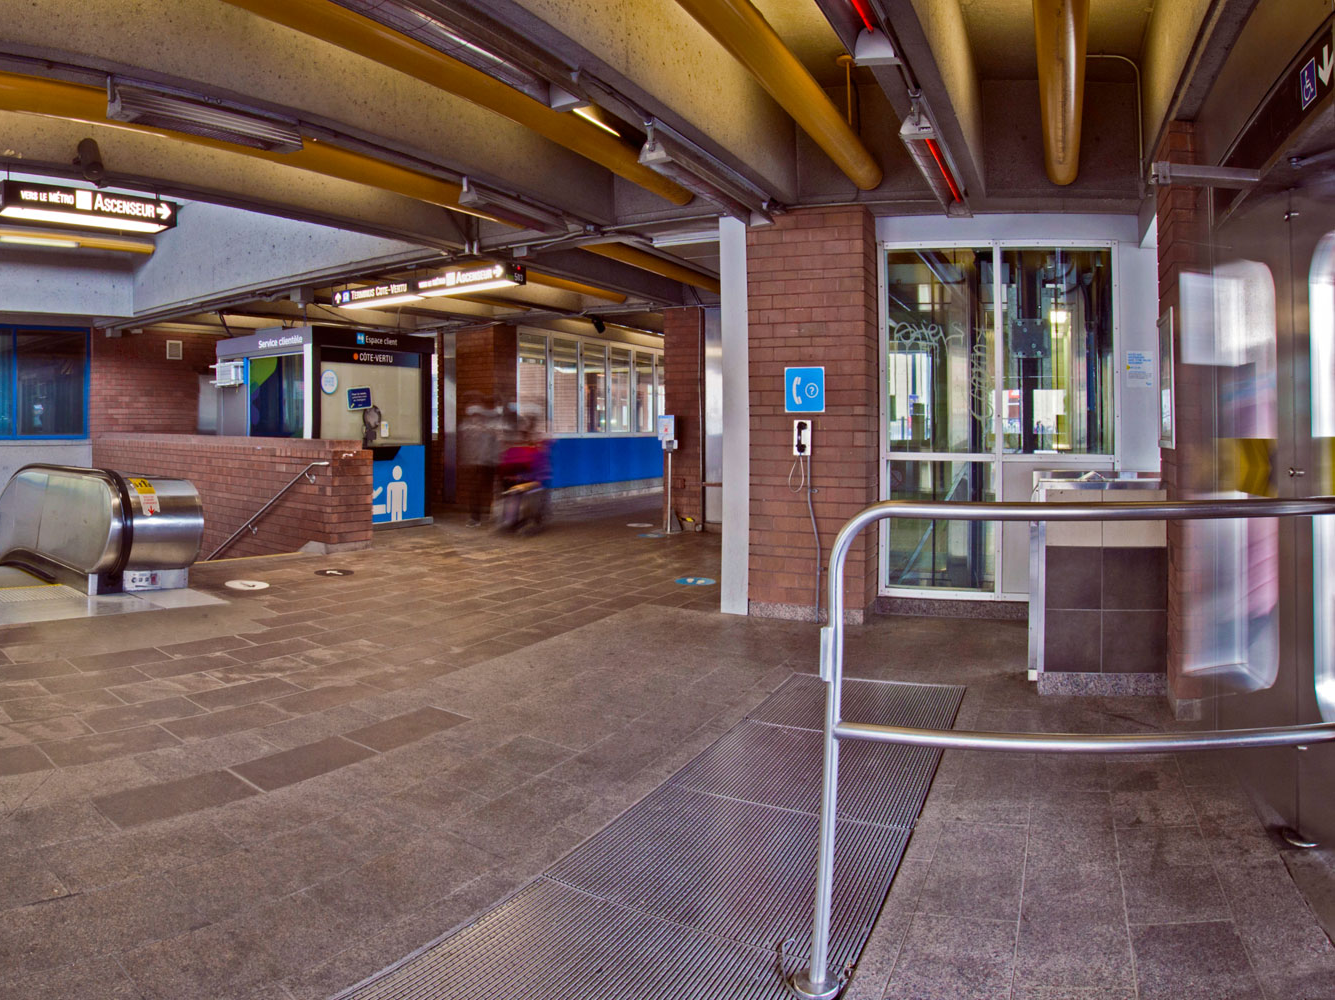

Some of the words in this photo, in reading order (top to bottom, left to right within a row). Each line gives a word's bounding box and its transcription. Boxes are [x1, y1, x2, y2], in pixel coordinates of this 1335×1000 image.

[20, 190, 39, 201] VERS
[40, 192, 48, 202] LE
[49, 191, 75, 206] MÉTRO
[94, 193, 155, 218] ASCENSEUR
[258, 339, 278, 349] Service
[279, 335, 303, 346] clientèle
[365, 335, 383, 346] Espace
[384, 337, 398, 346] client
[359, 352, 393, 363] CÔTE-VERTU
